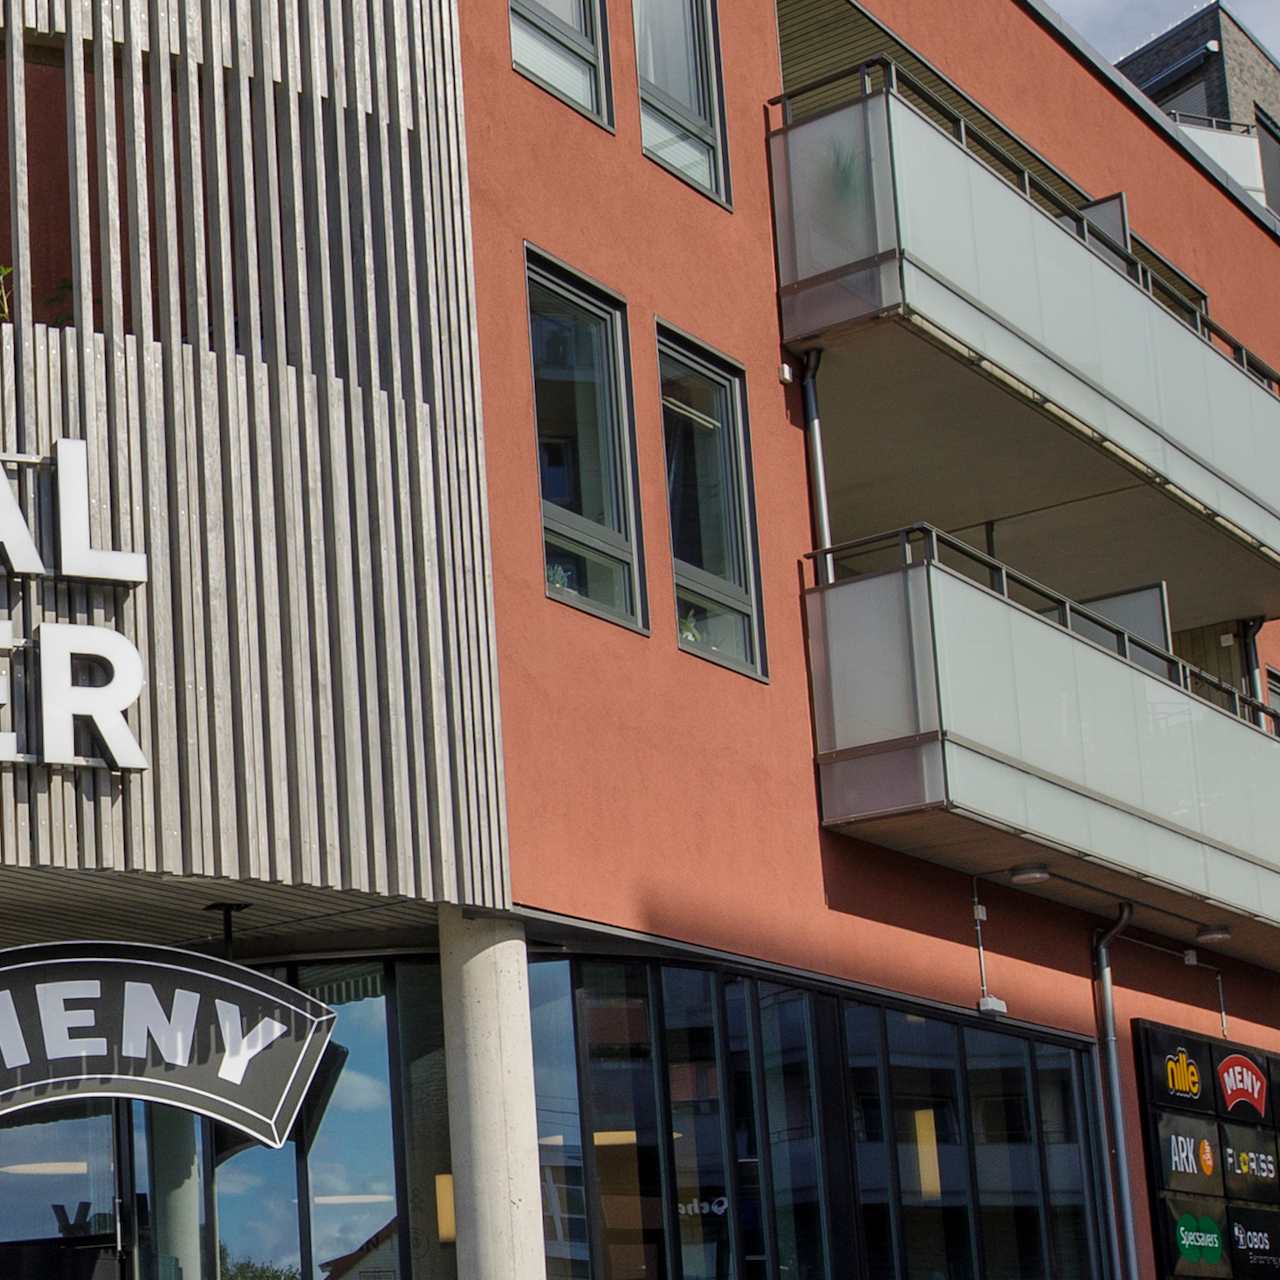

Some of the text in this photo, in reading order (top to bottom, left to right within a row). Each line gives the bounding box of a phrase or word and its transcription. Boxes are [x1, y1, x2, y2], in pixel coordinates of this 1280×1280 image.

[1167, 1050, 1200, 1096] nille
[1223, 1065, 1261, 1100] MENY
[1171, 1134, 1197, 1174] ARK
[1179, 1226, 1219, 1249] Specsavers
[1247, 1231, 1270, 1250] OBOS
